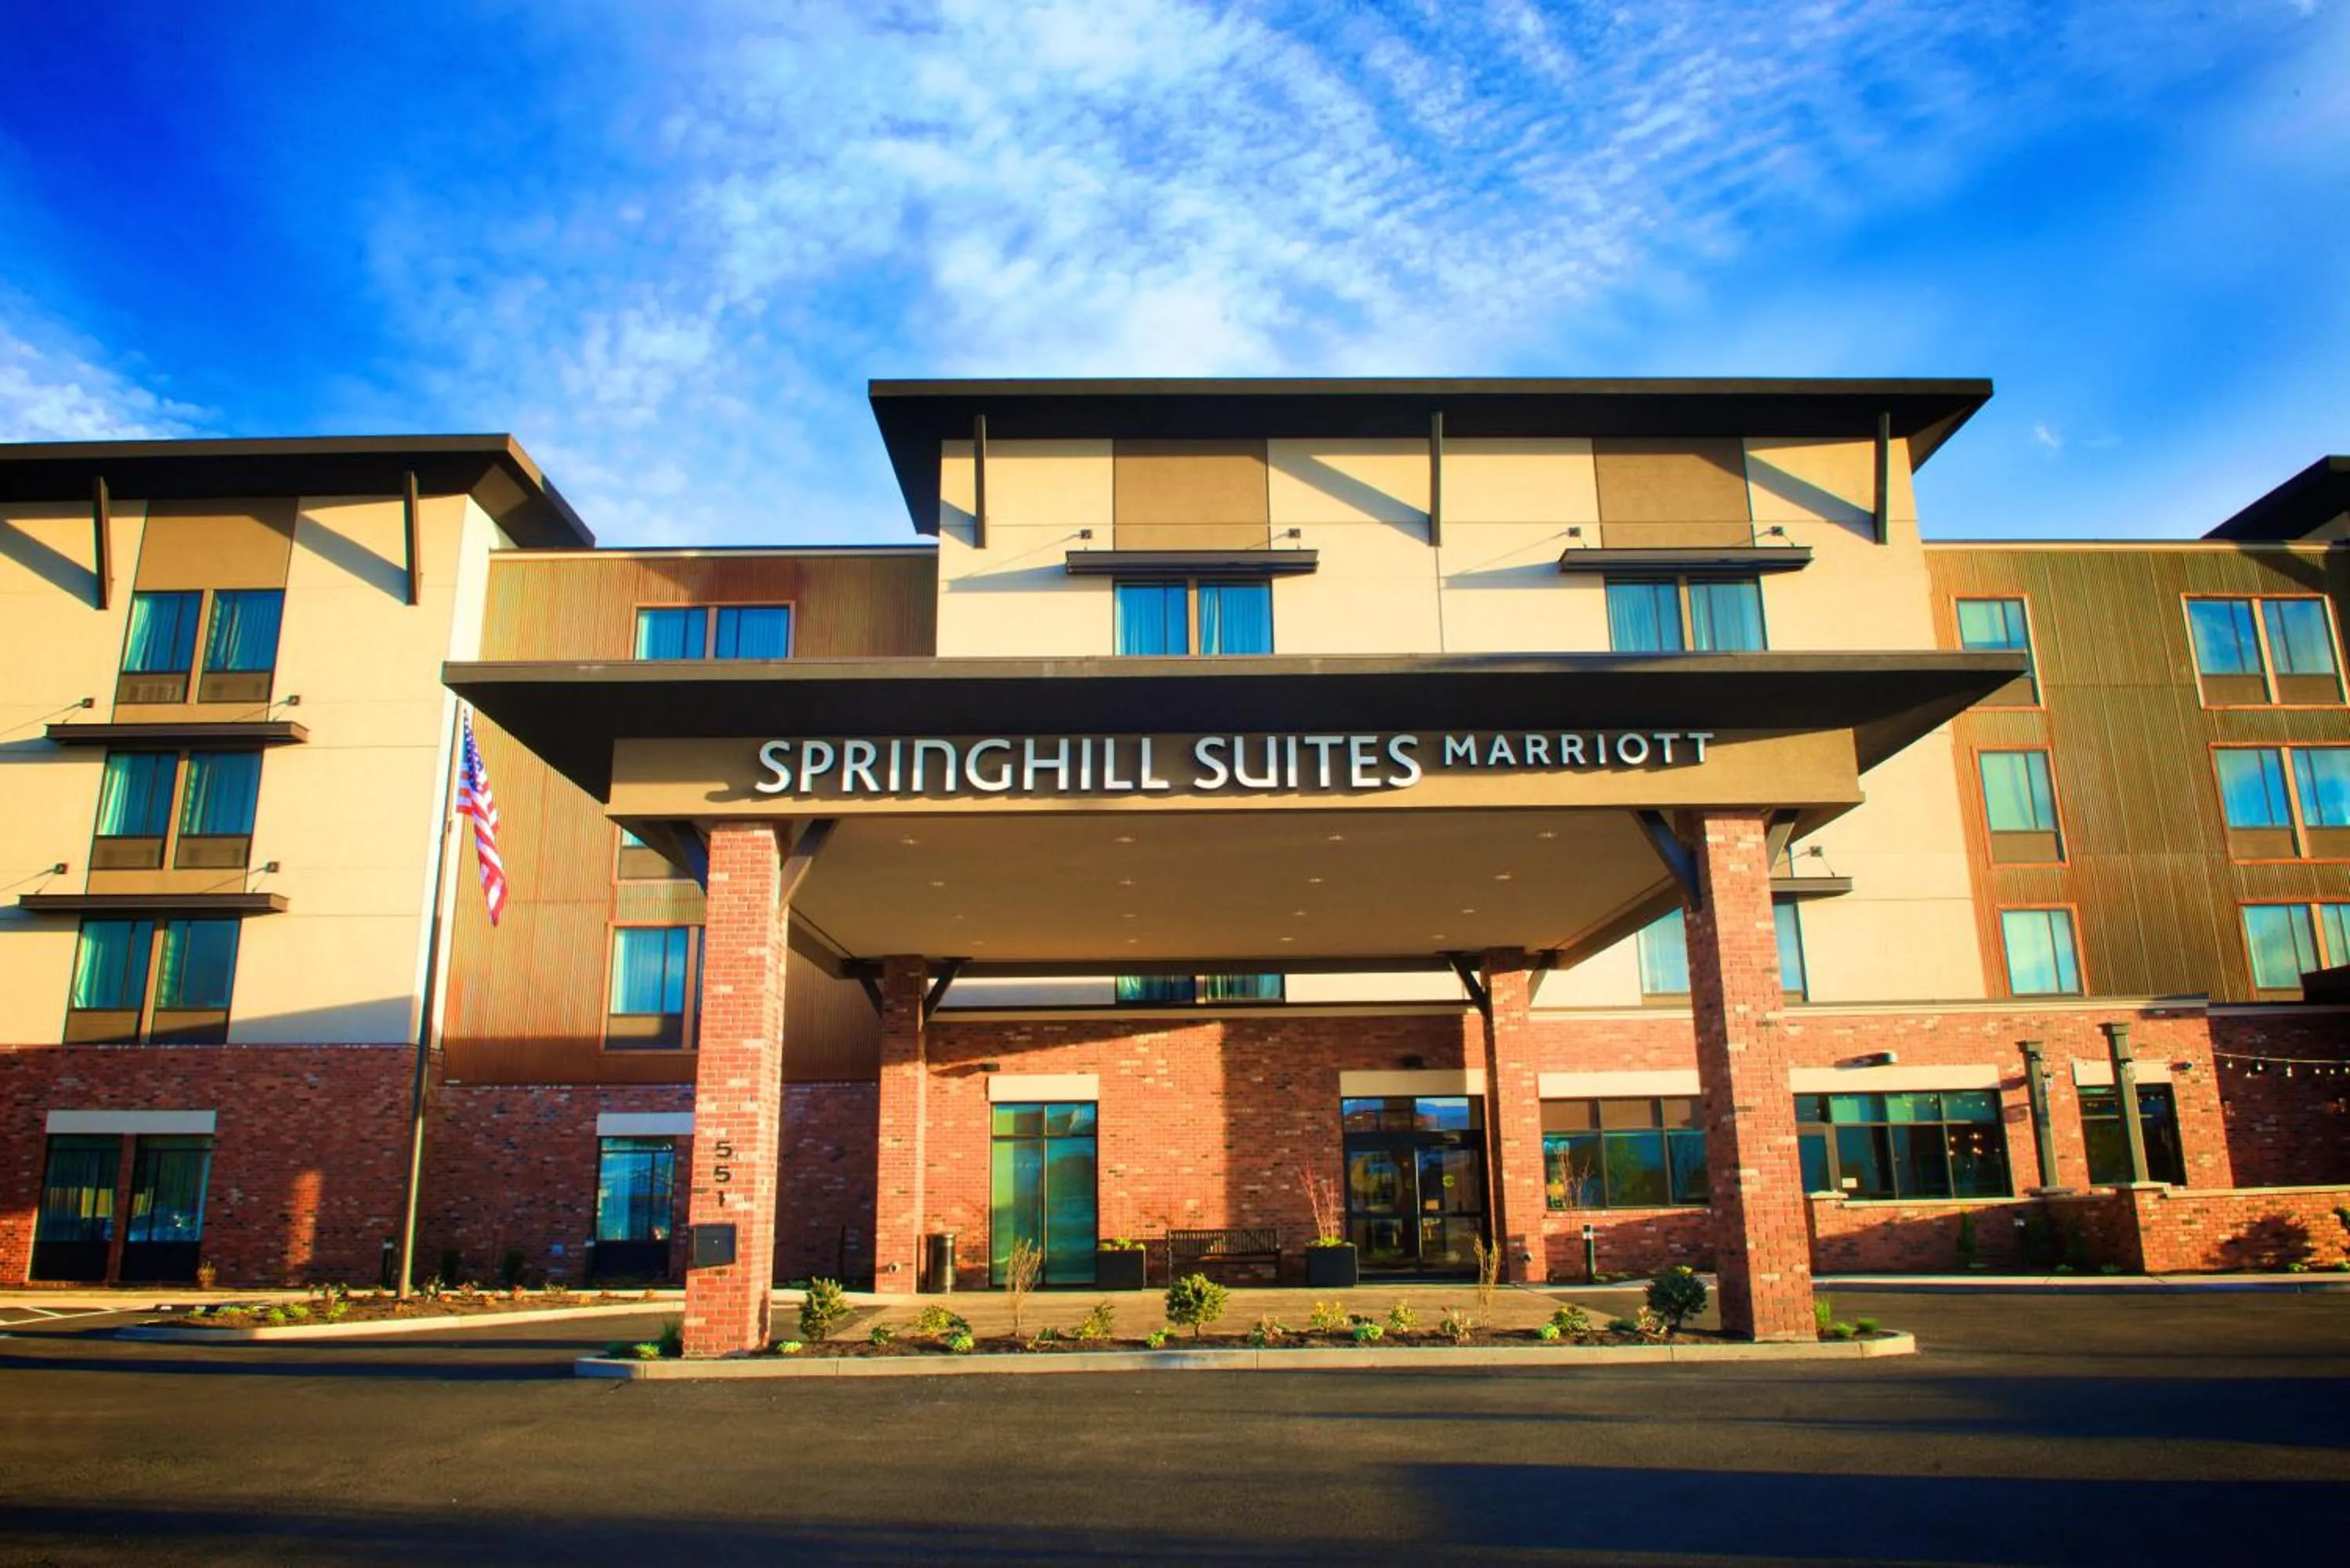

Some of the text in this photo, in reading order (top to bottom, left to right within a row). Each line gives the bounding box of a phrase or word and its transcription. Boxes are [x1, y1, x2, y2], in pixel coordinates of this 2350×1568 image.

[754, 732, 1714, 793] SPRINGHILL SUITES MARRIOTT
[714, 1140, 732, 1207] 551
